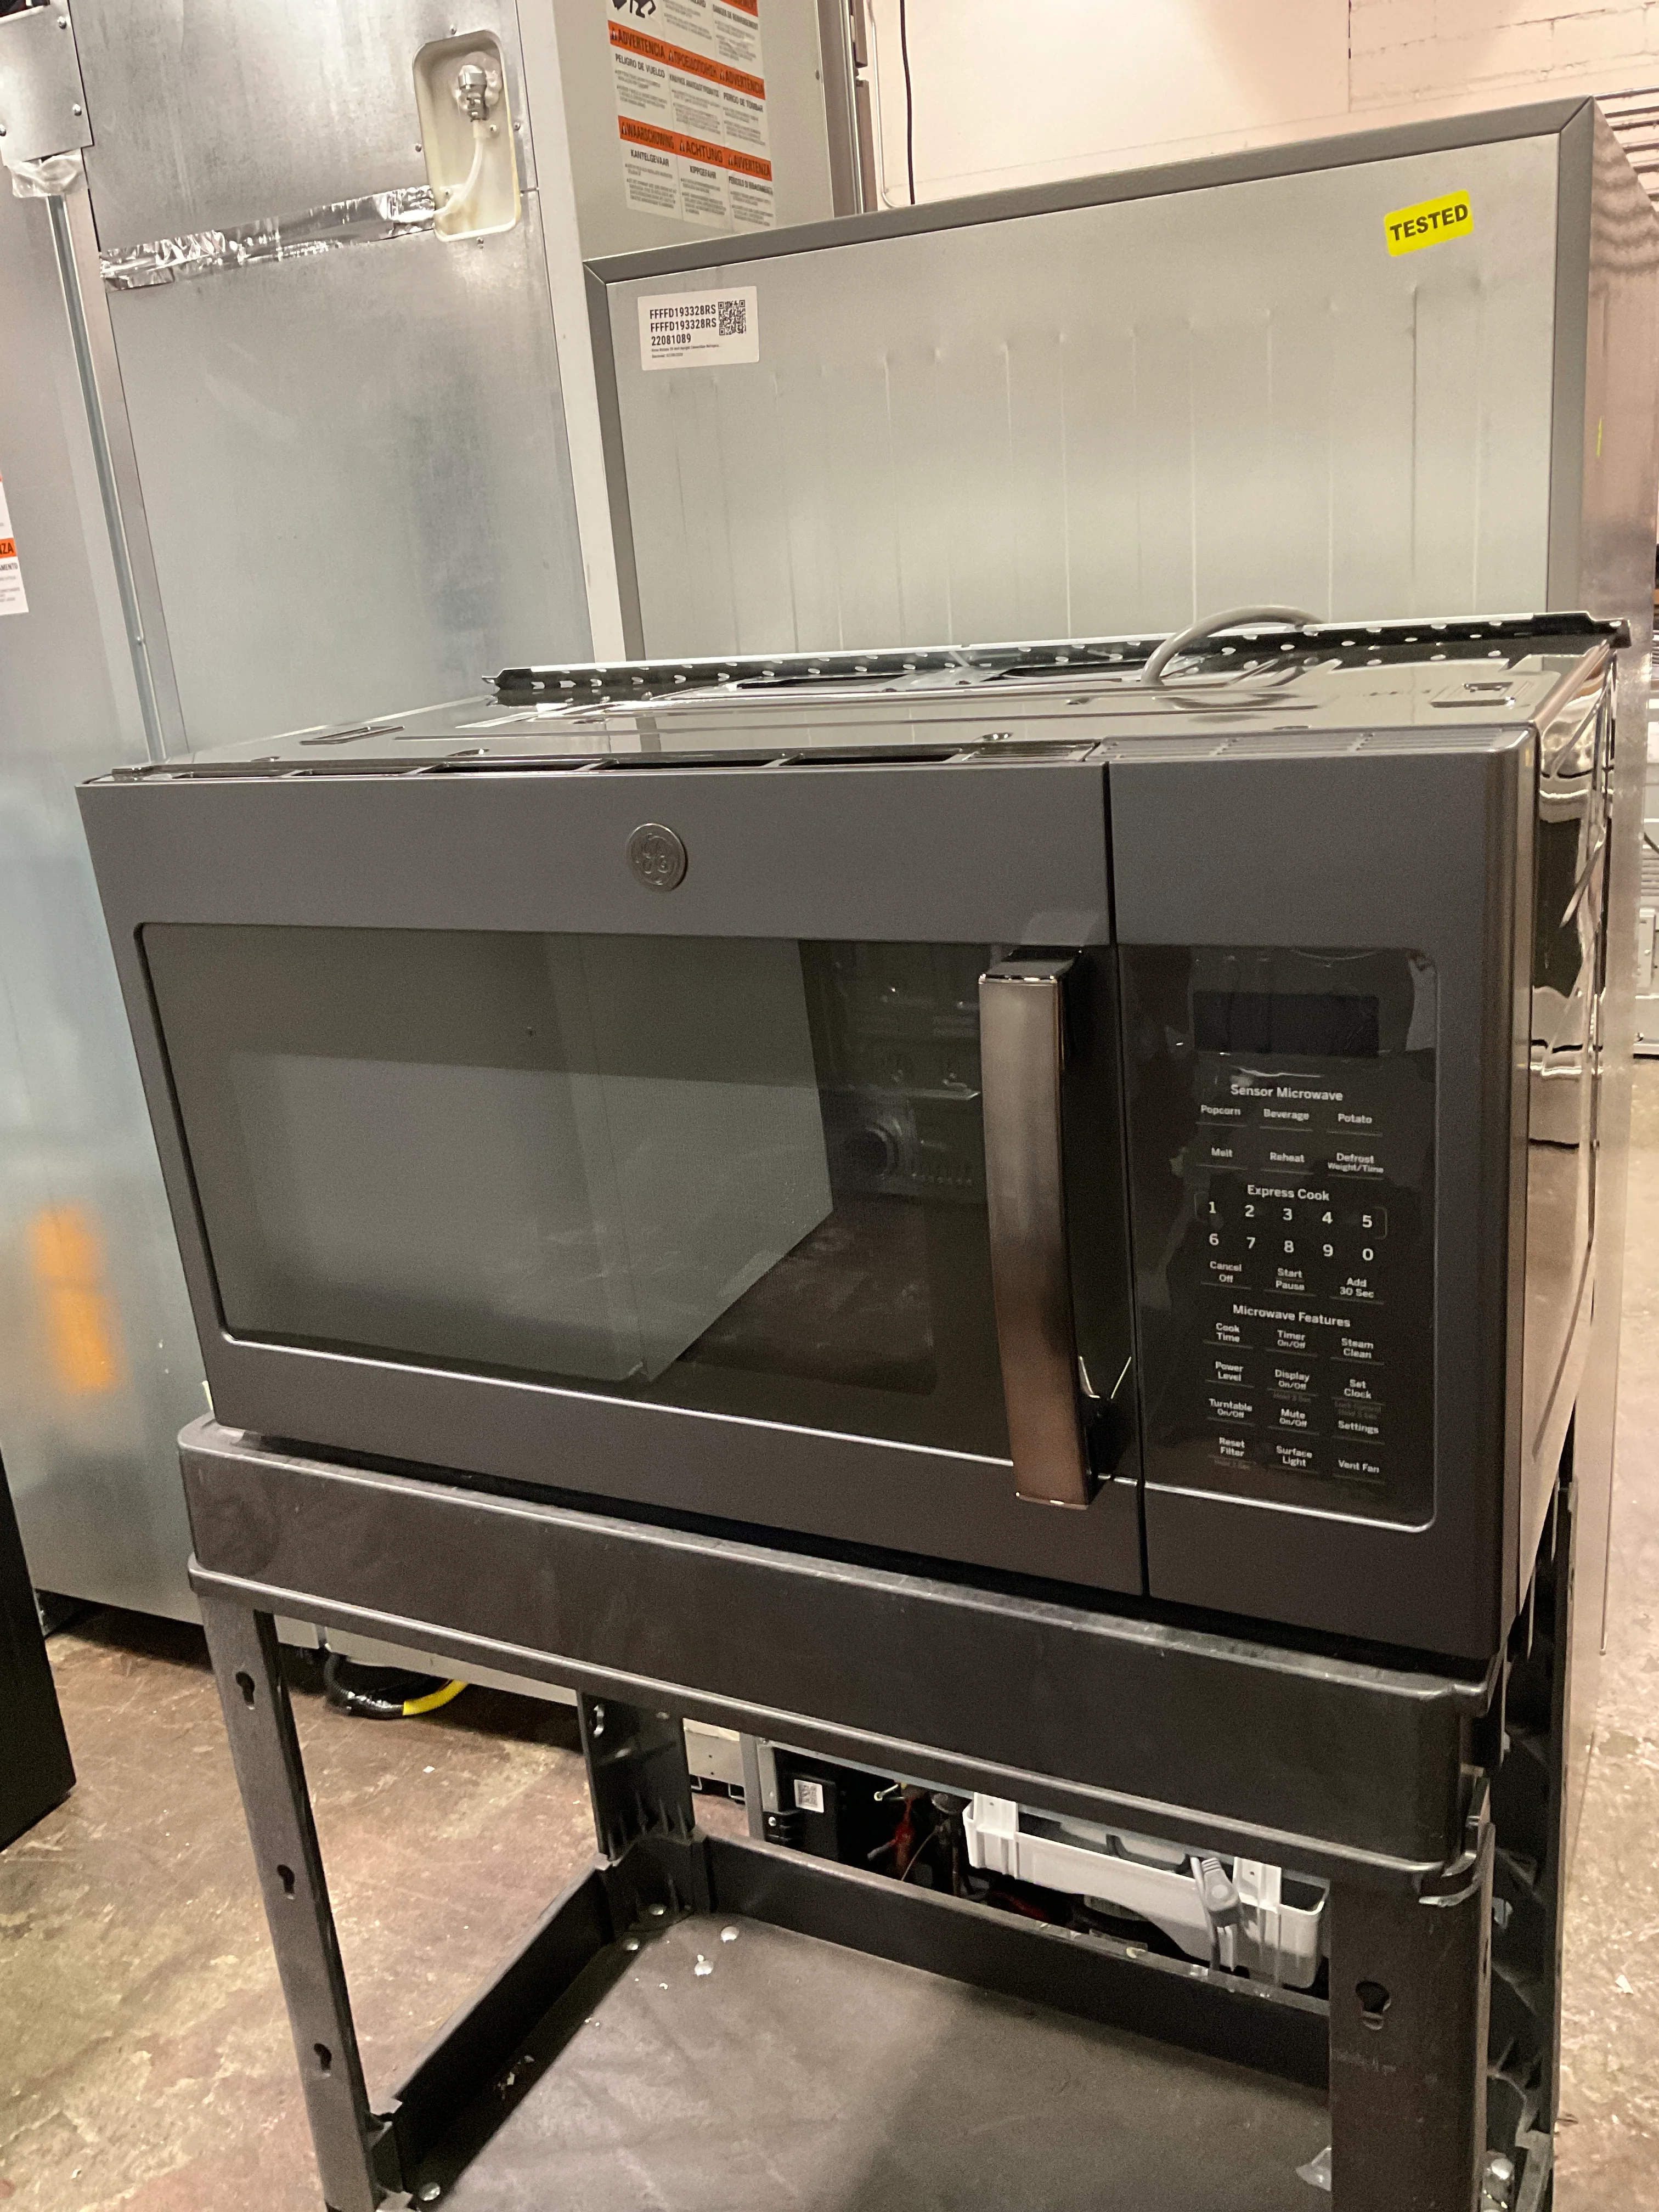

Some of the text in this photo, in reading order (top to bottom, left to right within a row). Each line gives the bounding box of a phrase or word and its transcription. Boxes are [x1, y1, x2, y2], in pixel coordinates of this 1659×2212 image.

[615, 53, 637, 69] PELIGRO
[637, 61, 645, 71] DE
[645, 63, 665, 78] VUELCO
[686, 140, 723, 163] ACHTUNG
[630, 149, 669, 167] KANTELGEVAAR
[1390, 204, 1468, 241] TESTED
[650, 304, 716, 319] FFFFD193328RS
[650, 318, 716, 332] FFFFD193328RS
[651, 333, 691, 346] 22081089
[1231, 1084, 1343, 1101] Sensor Microwave
[1201, 1105, 1240, 1115] Popcorn
[1264, 1109, 1309, 1121] Beverage
[1338, 1113, 1372, 1123] Potato
[1211, 1148, 1232, 1157] Melt
[1270, 1152, 1304, 1163] Reheat
[1337, 1153, 1374, 1164] Defrost
[1328, 1162, 1384, 1173] Weight/Time
[1248, 1185, 1329, 1200] Express Cook
[1209, 1201, 1372, 1227] 1 2 3 4 5
[1210, 1233, 1373, 1261] 6 7 8 9 0
[1210, 1261, 1242, 1271] Cancel
[1219, 1274, 1233, 1283] Off
[1278, 1268, 1302, 1278] Start
[1276, 1280, 1305, 1290] Pause
[1346, 1278, 1367, 1288] Add
[1340, 1286, 1374, 1298] 30 Sec
[1233, 1305, 1350, 1327] Microwave Features
[1216, 1323, 1239, 1334] Cook
[1217, 1332, 1240, 1342] Time
[1277, 1330, 1305, 1341] Timer
[1277, 1340, 1306, 1348] On/Off
[1342, 1338, 1373, 1350] Steam
[1344, 1348, 1372, 1358] Clean
[1216, 1361, 1243, 1373] Power
[1218, 1371, 1242, 1381] Level
[1275, 1369, 1310, 1383] Display
[1278, 1380, 1307, 1390] On/Off
[1349, 1379, 1365, 1390] Set
[1344, 1388, 1371, 1398] Clock
[1209, 1398, 1252, 1412] Turntable
[1217, 1408, 1245, 1418] On/Off
[1280, 1409, 1305, 1420] Mute
[1279, 1418, 1307, 1427] On/Off
[1339, 1420, 1379, 1434] Settings
[1219, 1437, 1245, 1449] Reset
[1221, 1446, 1245, 1456] Filter
[1277, 1446, 1312, 1459] Surface
[1283, 1455, 1307, 1466] Light
[1339, 1460, 1379, 1472] Vent Fan
